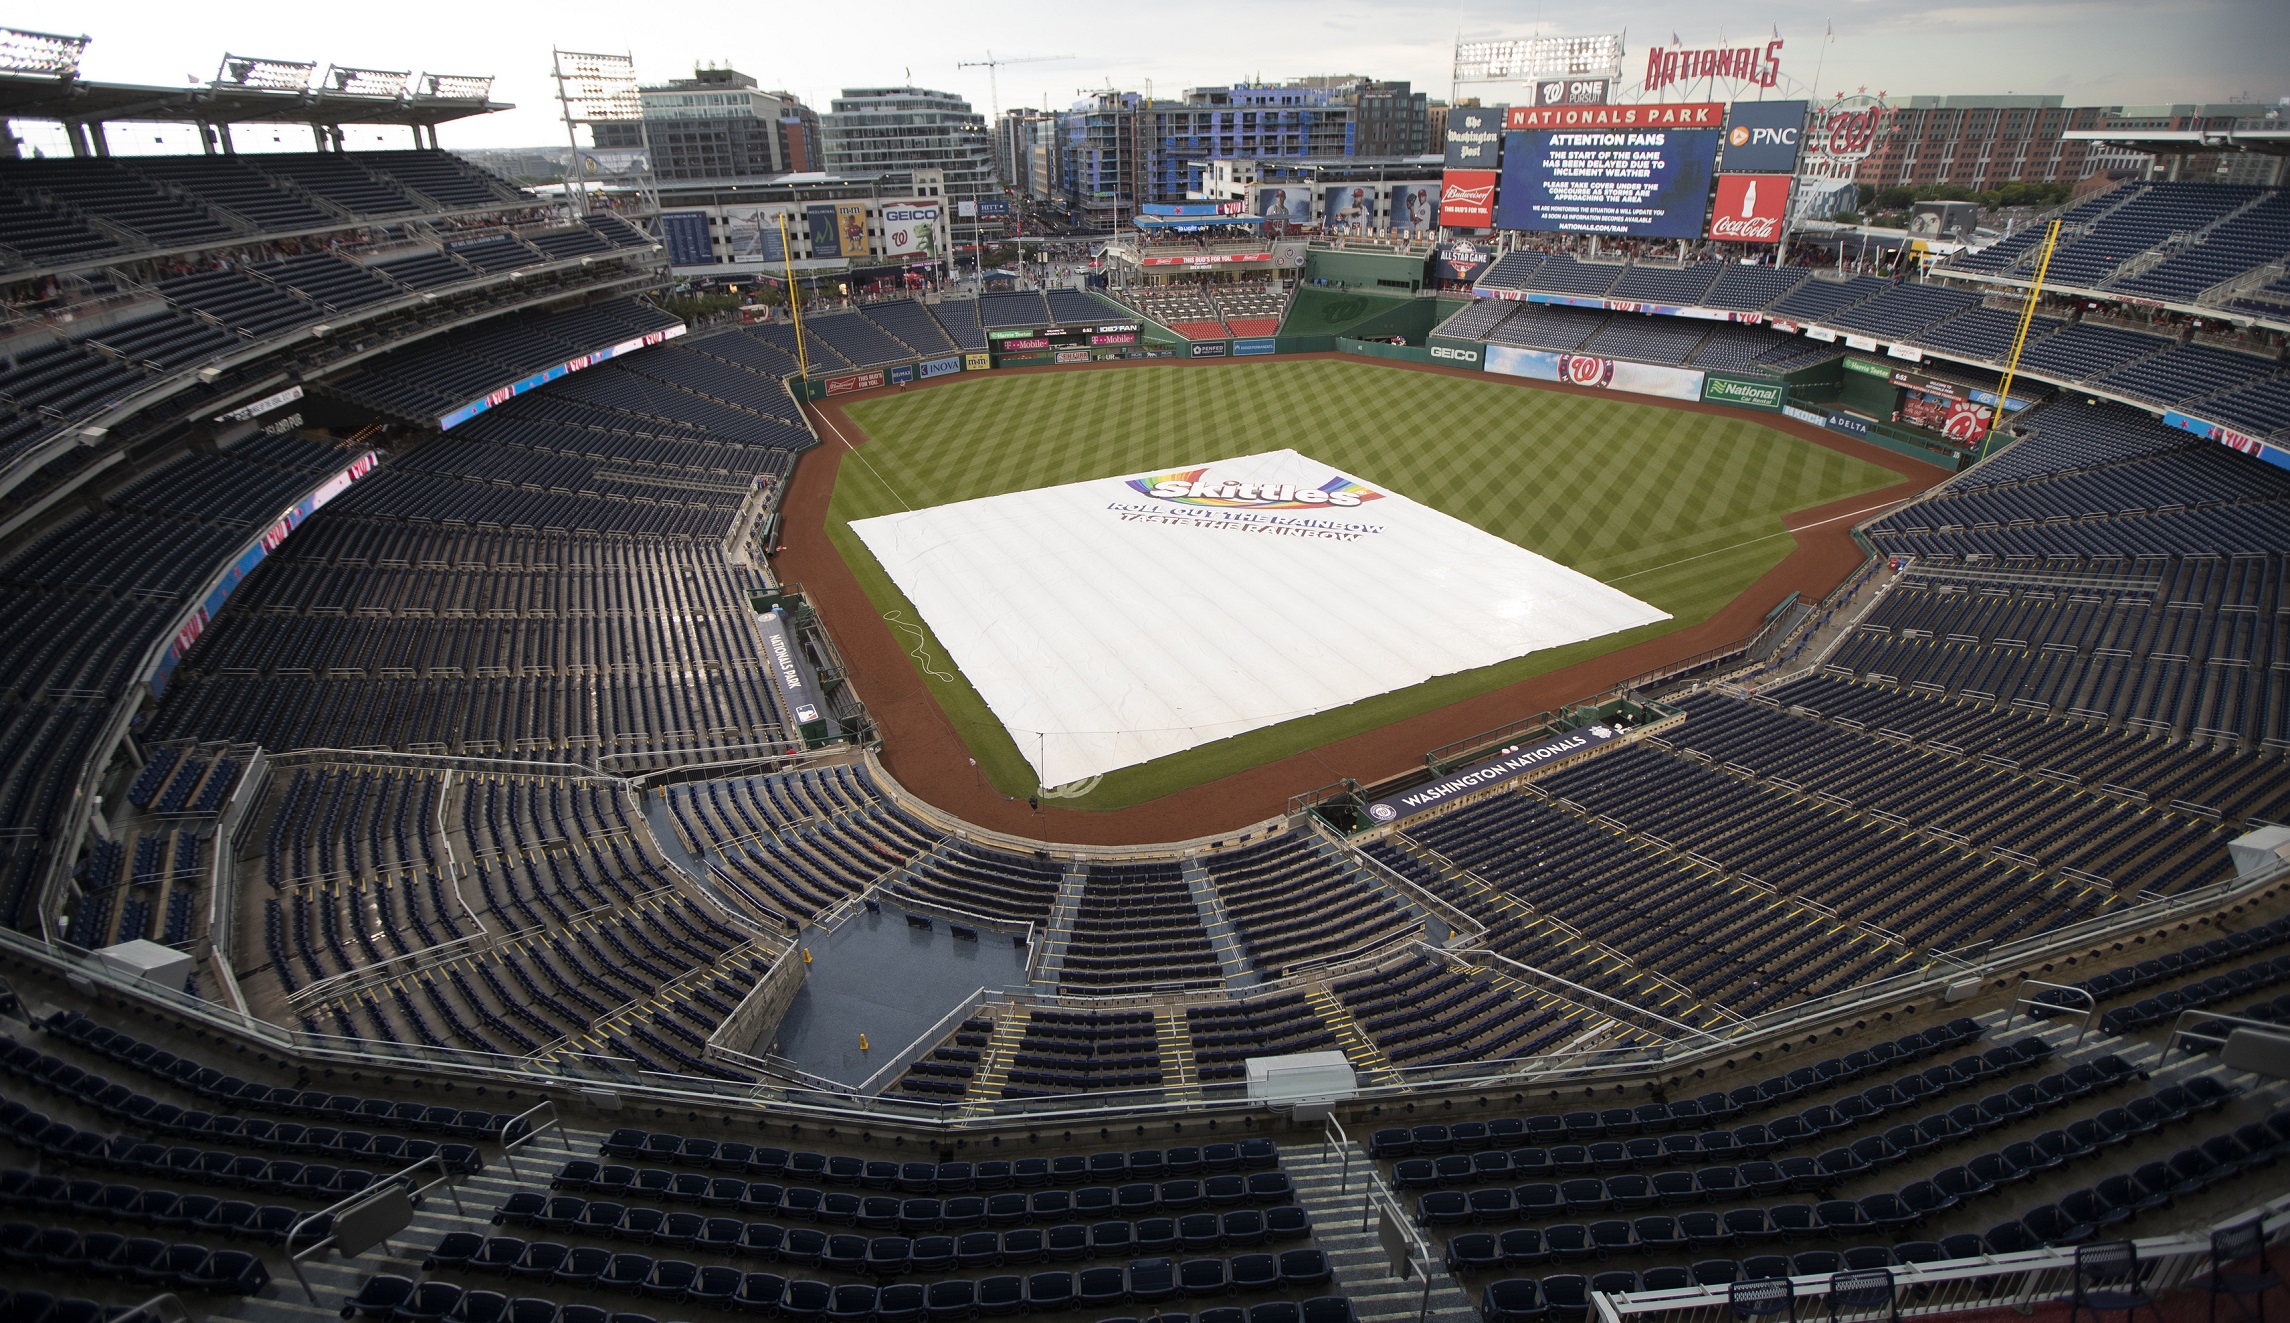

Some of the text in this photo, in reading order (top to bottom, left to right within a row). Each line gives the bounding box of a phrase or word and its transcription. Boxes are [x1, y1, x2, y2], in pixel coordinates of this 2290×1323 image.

[1645, 40, 1783, 90] NATIONALS
[1570, 81, 1603, 94] ONE
[1569, 93, 1600, 103] PURSUIT
[1465, 116, 1482, 128] The
[1513, 108, 1710, 124] NATIONALS PARK
[1448, 129, 1498, 145] Washington
[1549, 134, 1665, 146] ATTENTION FANS
[1752, 128, 1797, 145] PNC
[1461, 146, 1480, 160] Post
[1568, 151, 1596, 160] START
[1613, 152, 1631, 160] THE
[1632, 152, 1660, 160] GAME
[1542, 160, 1665, 169] HAS BEEN DELAYED DUE TO
[1553, 168, 1650, 178] INCLEMENT WEATHER
[1621, 195, 1642, 203] AREA
[886, 210, 937, 221] GEICO
[1559, 223, 1628, 233] NATIONALS.COM/RAIN
[1712, 215, 1779, 238] Coca-Cola
[1440, 251, 1487, 263] ALL STAR GAME
[1430, 346, 1477, 362] GEICO
[930, 360, 959, 373] INOVA
[1752, 397, 1772, 405] Rental
[1838, 418, 1867, 434] DELTA
[1152, 480, 1361, 507] Skittles
[1107, 502, 1388, 533] ROLL OUT THE RAINBOW
[1120, 512, 1364, 543] TASTE THE RAINBOW
[769, 634, 802, 689] NATIONALS PARK
[1401, 735, 1587, 807] WASHINGTON NATIONALS
